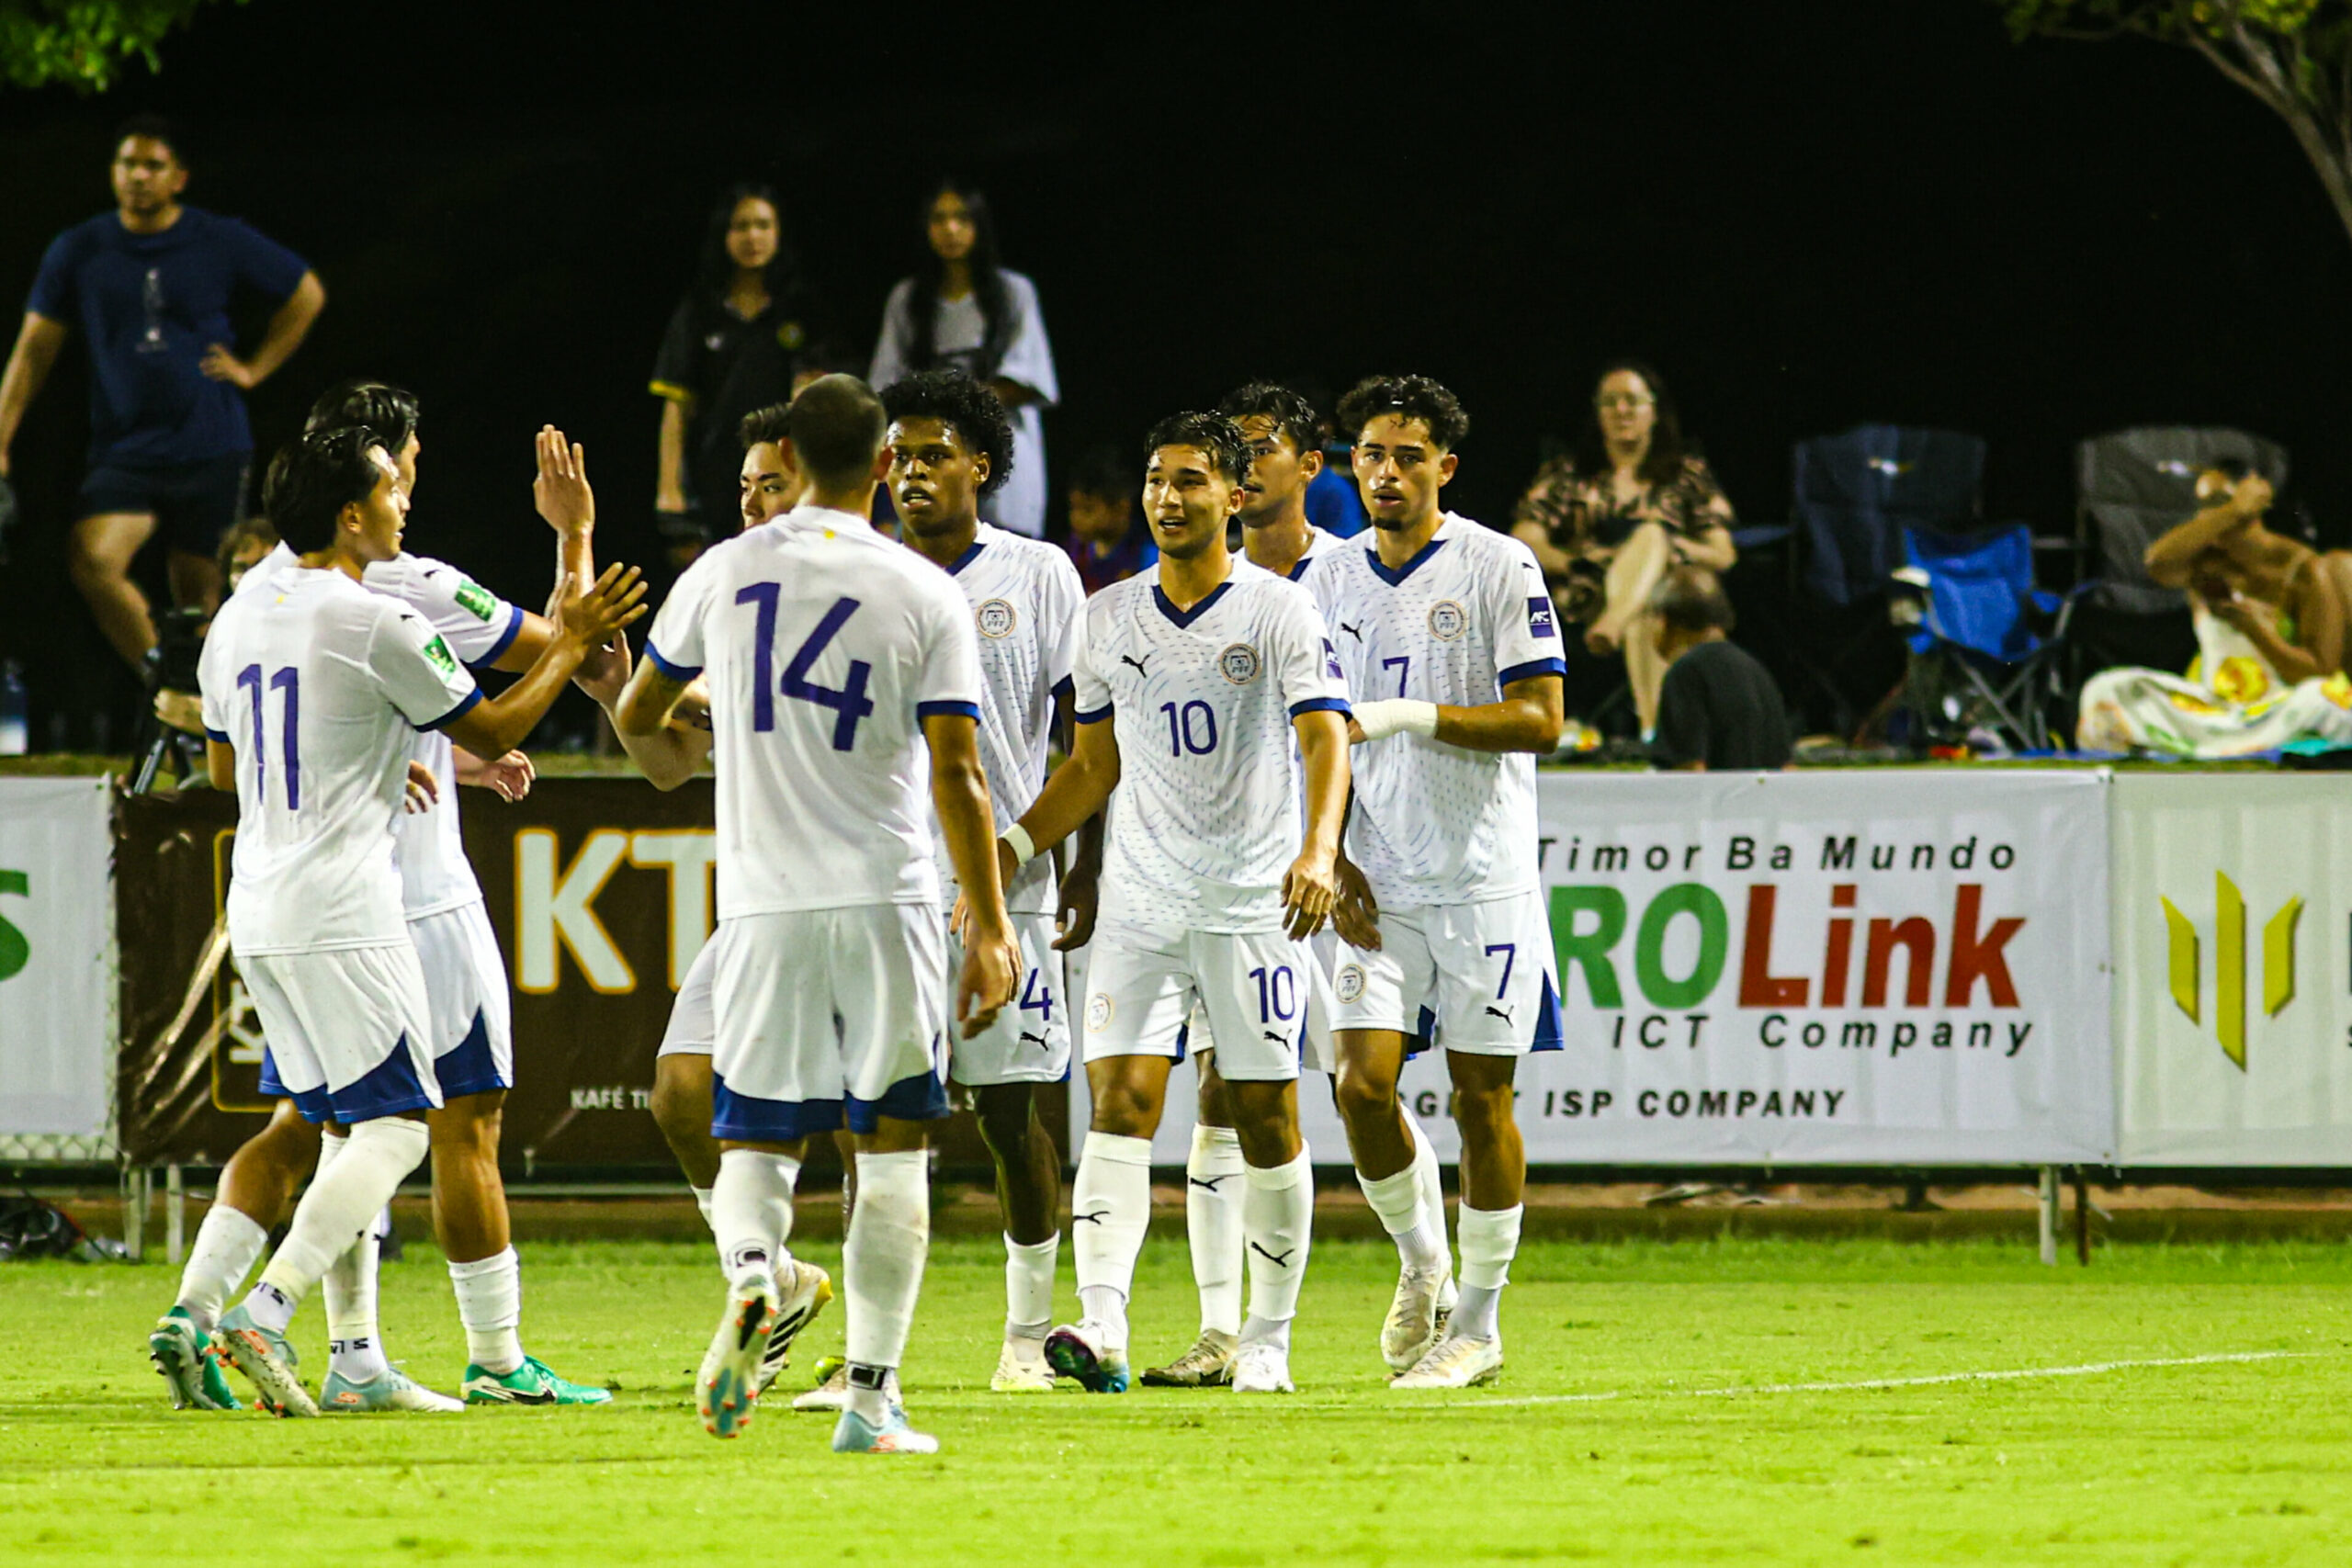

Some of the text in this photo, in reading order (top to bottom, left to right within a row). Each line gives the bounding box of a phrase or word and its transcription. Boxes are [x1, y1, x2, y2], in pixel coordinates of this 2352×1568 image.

[736, 581, 874, 751] 14
[1383, 656, 1409, 698] 7
[237, 663, 299, 810] 11
[1159, 699, 1217, 757] 10
[1726, 837, 1792, 871] Ba
[1820, 835, 2015, 870] Mundo
[1249, 965, 1295, 1023] 10
[1485, 942, 1515, 999] 7
[1613, 1013, 2032, 1057] ICT Company
[1544, 1090, 1612, 1117] ISP
[1637, 1090, 1845, 1117] COMPANY
